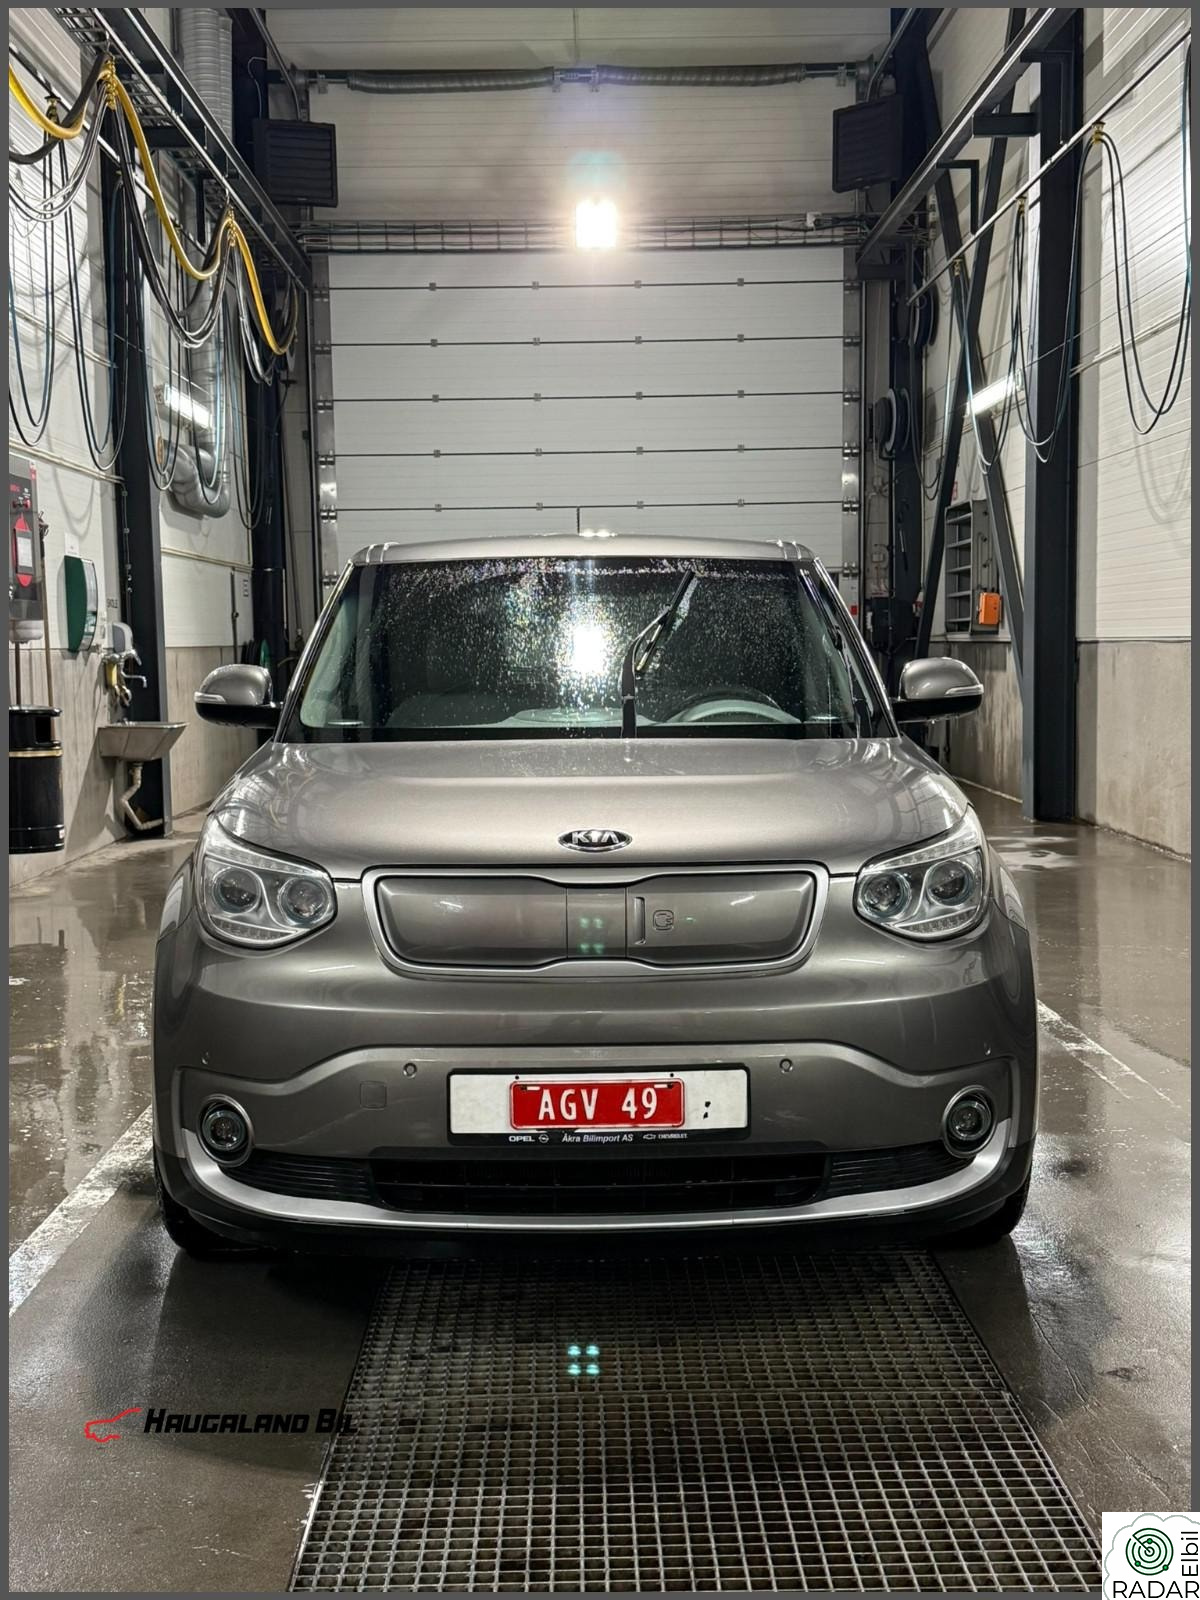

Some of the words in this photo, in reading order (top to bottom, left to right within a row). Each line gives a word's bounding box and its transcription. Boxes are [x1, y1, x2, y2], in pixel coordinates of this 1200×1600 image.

[571, 829, 619, 844] KIA
[538, 1088, 599, 1121] AGV
[621, 1087, 658, 1120] 49
[561, 1132, 581, 1143] Åkra
[582, 1133, 620, 1144] Bilimport
[621, 1133, 634, 1142] AS
